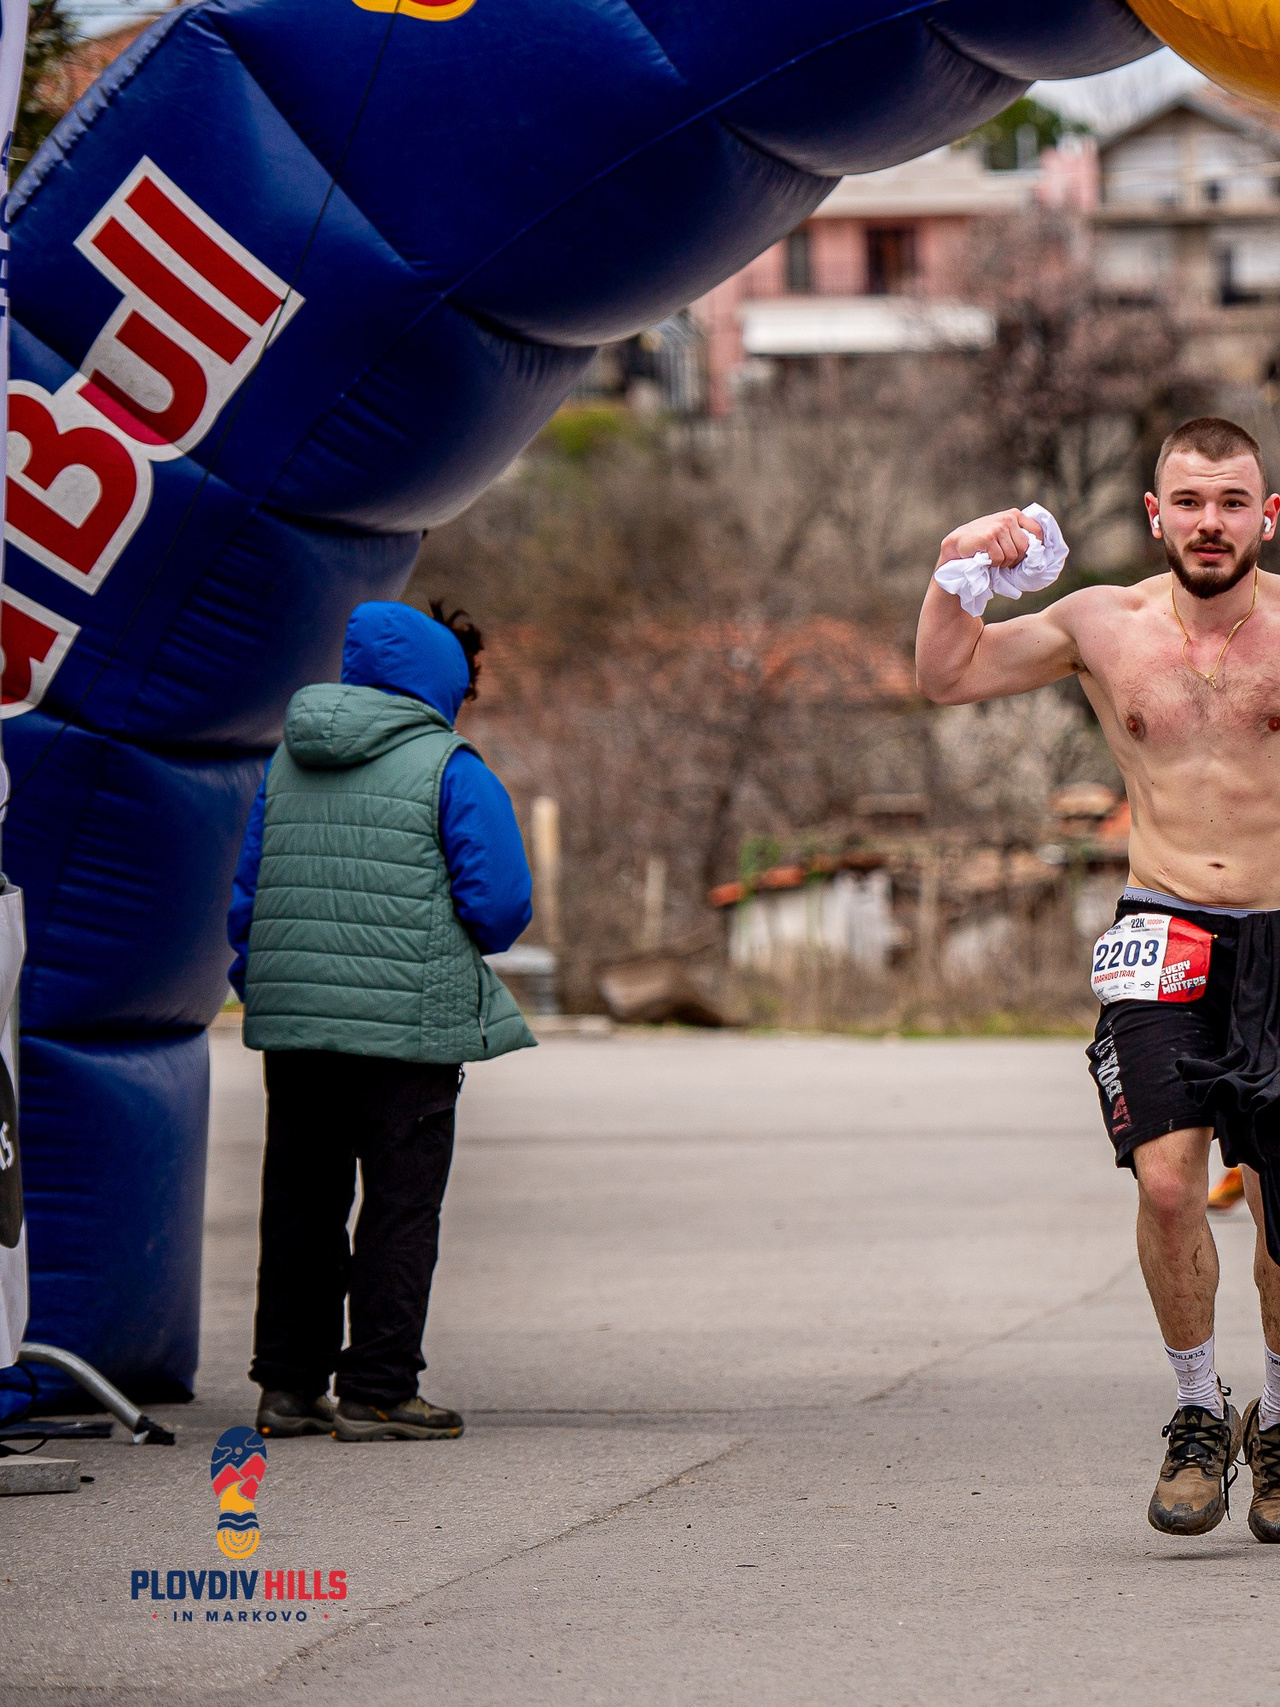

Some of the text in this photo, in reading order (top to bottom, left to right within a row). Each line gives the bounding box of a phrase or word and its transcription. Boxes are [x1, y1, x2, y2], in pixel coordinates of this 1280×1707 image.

[4, 166, 294, 585] Bull
[1131, 918, 1145, 928] 22K
[1094, 939, 1160, 972] 2203
[1094, 969, 1136, 984] MARKOVO TRAIL
[1160, 960, 1190, 977] EVERY
[1160, 971, 1186, 985] STEP
[1162, 975, 1207, 994] MATTERS
